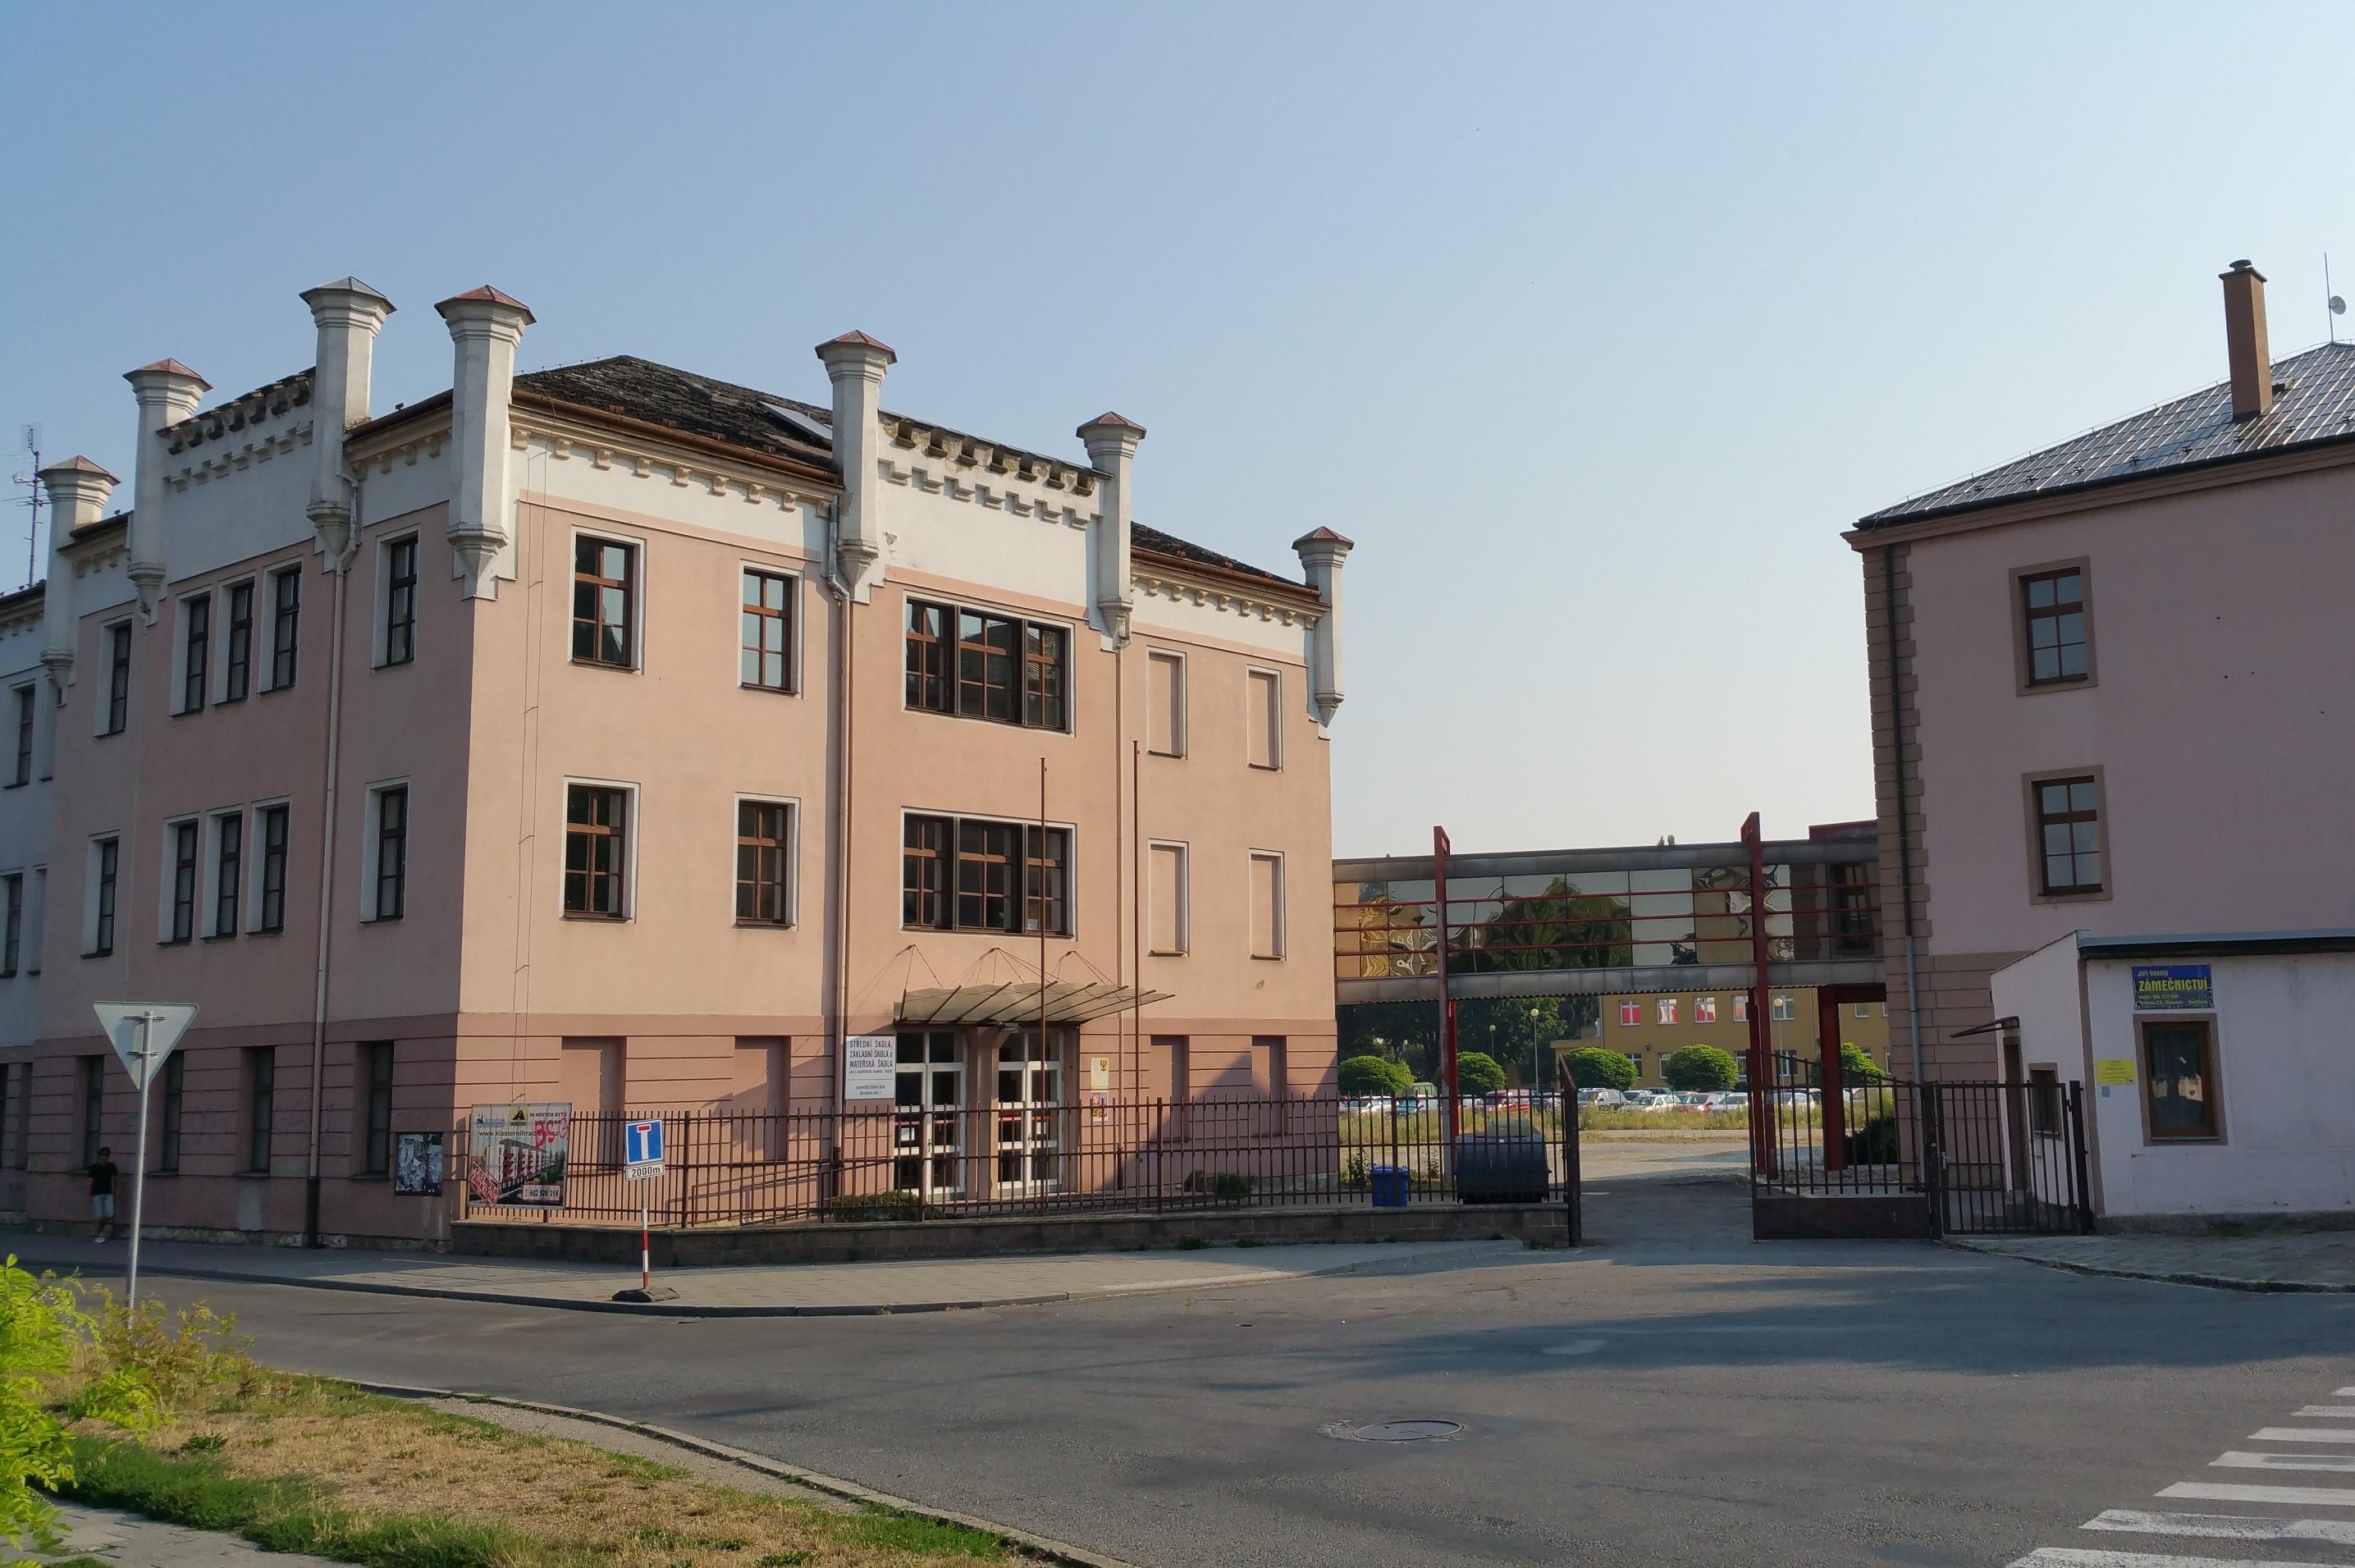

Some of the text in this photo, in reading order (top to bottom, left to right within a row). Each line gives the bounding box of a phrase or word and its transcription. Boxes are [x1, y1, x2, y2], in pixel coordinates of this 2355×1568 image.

[849, 1039, 893, 1049] STŘEDNÍ ŠKOLA,
[849, 1049, 873, 1058] ZÁKLADNÍ
[874, 1049, 889, 1058] ŠKOLA
[849, 1059, 893, 1068] MATEŘSKÁ ŠKOLA
[631, 1166, 661, 1177] 2000m
